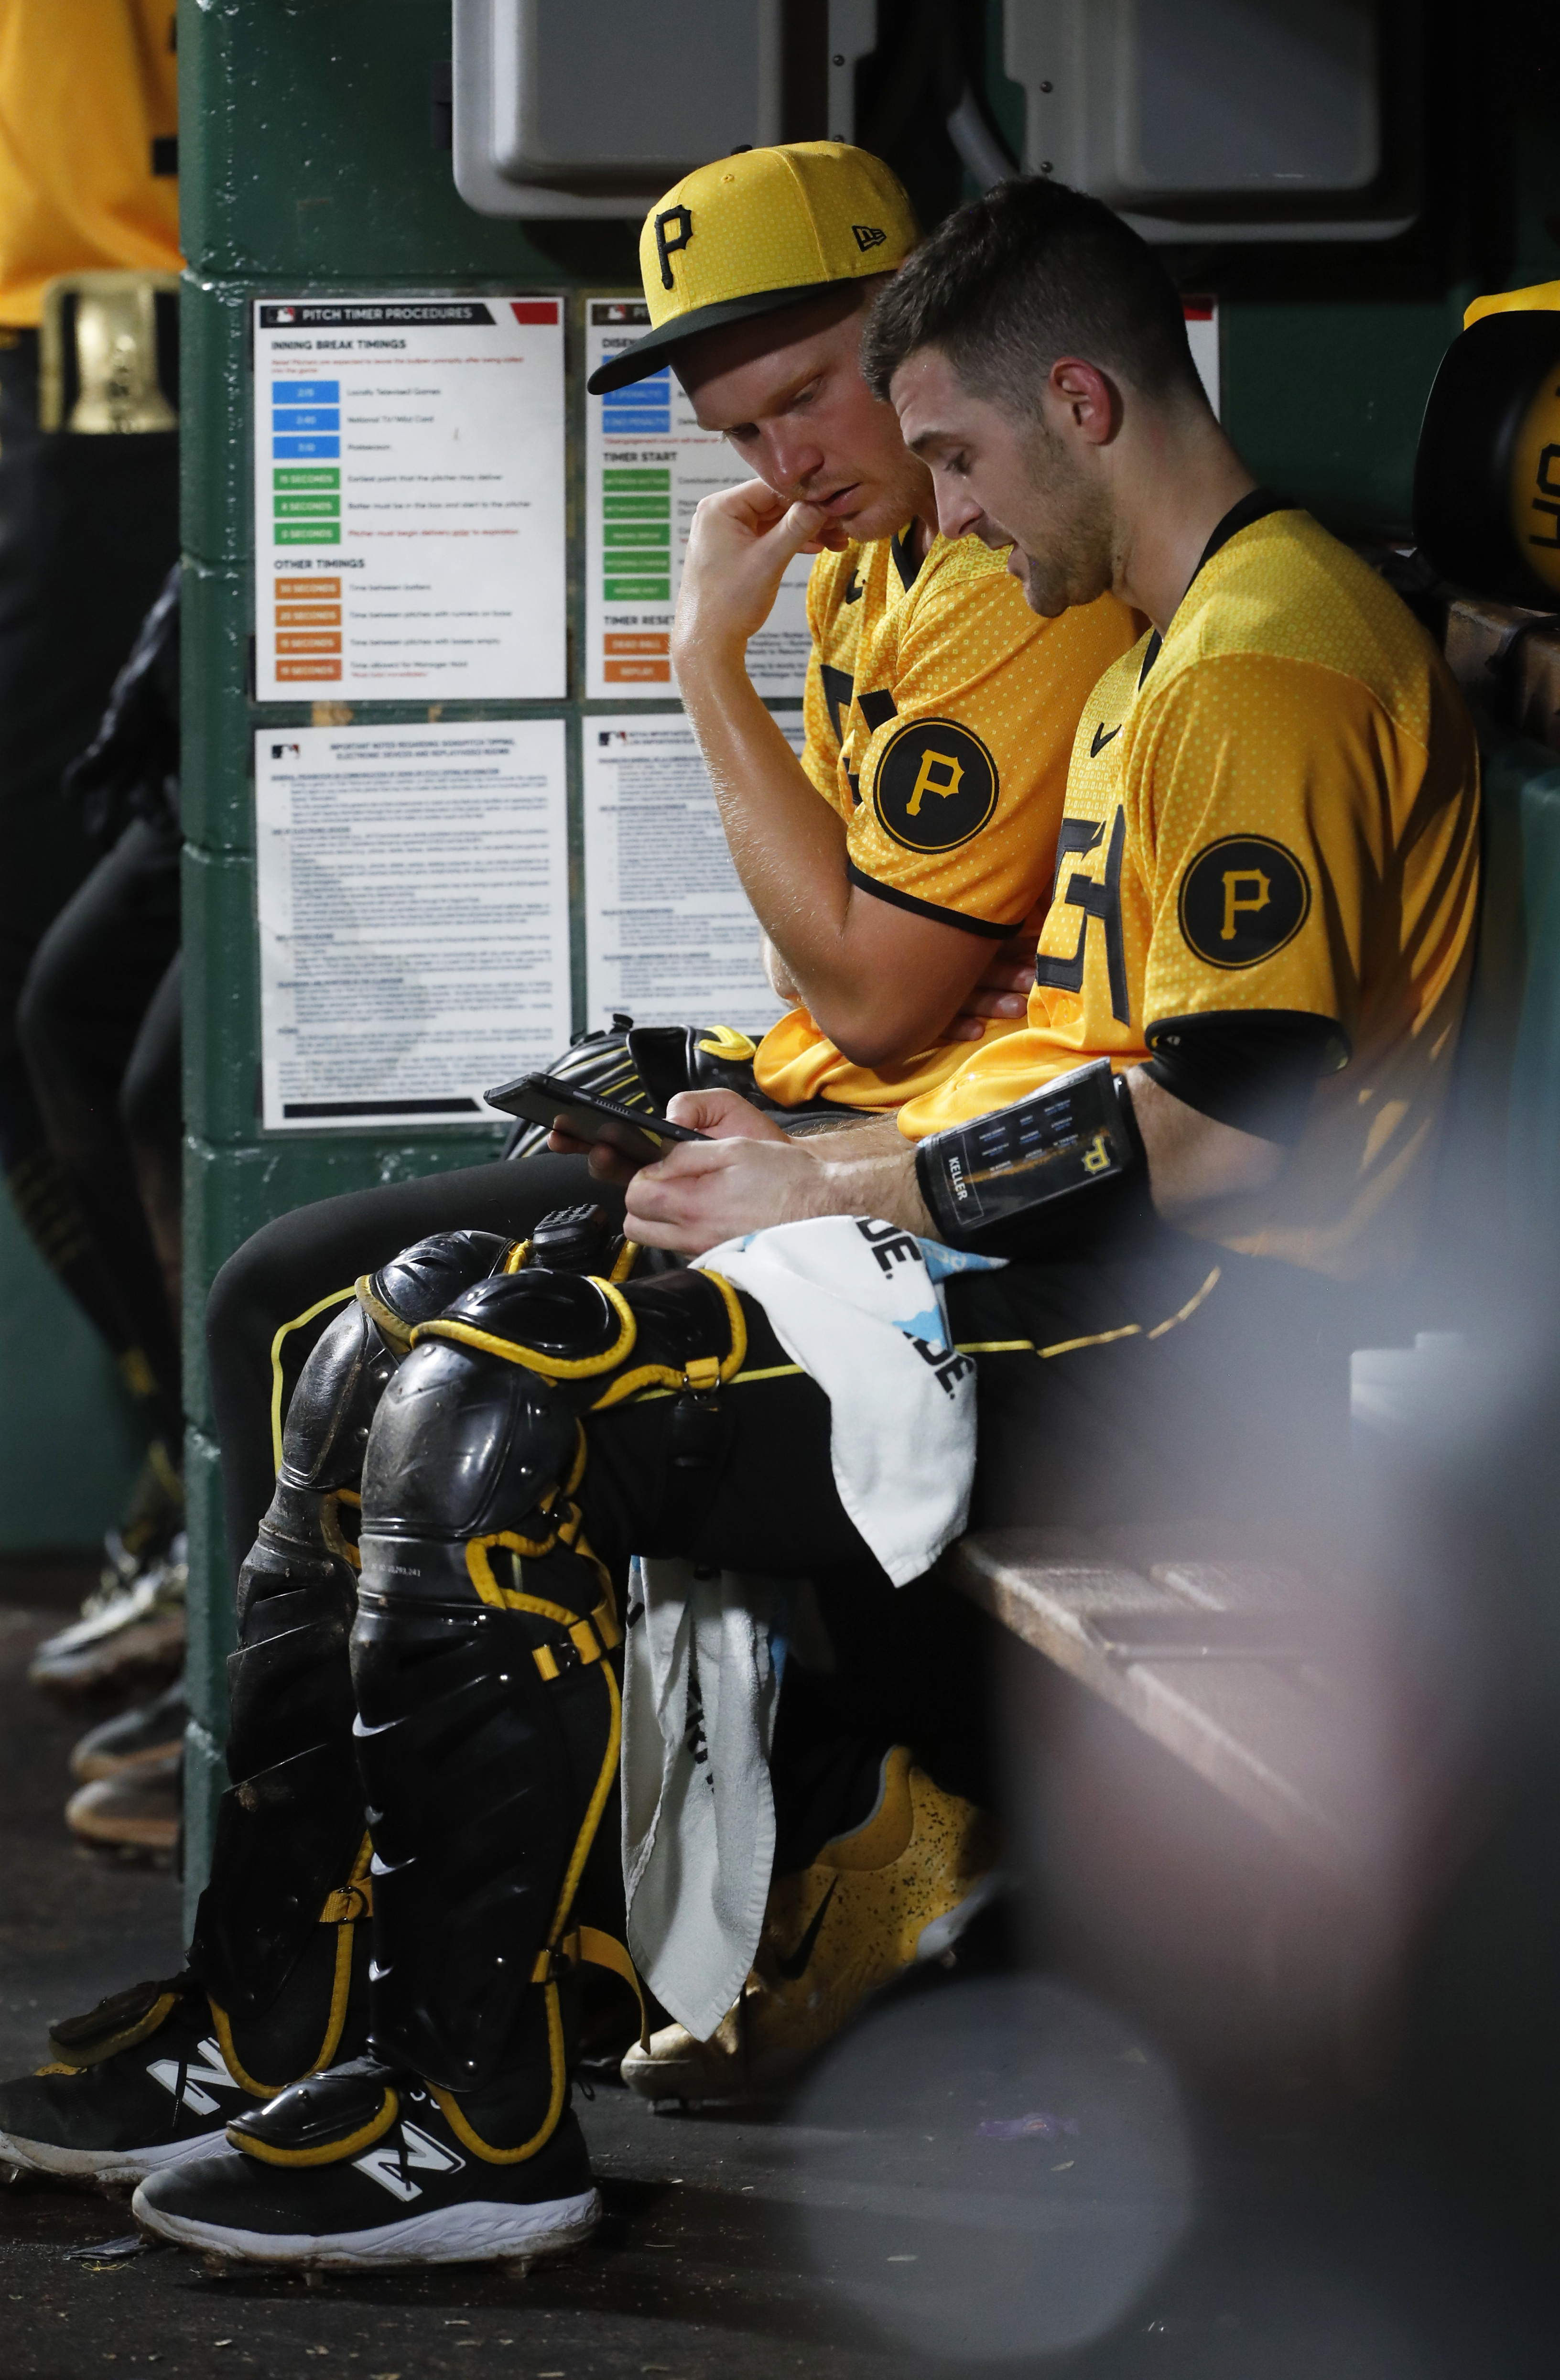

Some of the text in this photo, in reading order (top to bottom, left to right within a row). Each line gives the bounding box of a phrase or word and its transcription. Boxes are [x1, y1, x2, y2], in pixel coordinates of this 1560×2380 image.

[654, 204, 693, 290] P
[303, 307, 473, 321] PITCH TIMER PROCEDURES
[271, 339, 406, 350] INNING BREAK TIMINGS
[604, 451, 678, 462] TIMER START
[274, 558, 366, 569] OTHER TIMINGS
[604, 616, 638, 625] TIMER
[906, 749, 965, 816] P
[1220, 868, 1271, 940] P
[948, 1156, 968, 1201] KELLER
